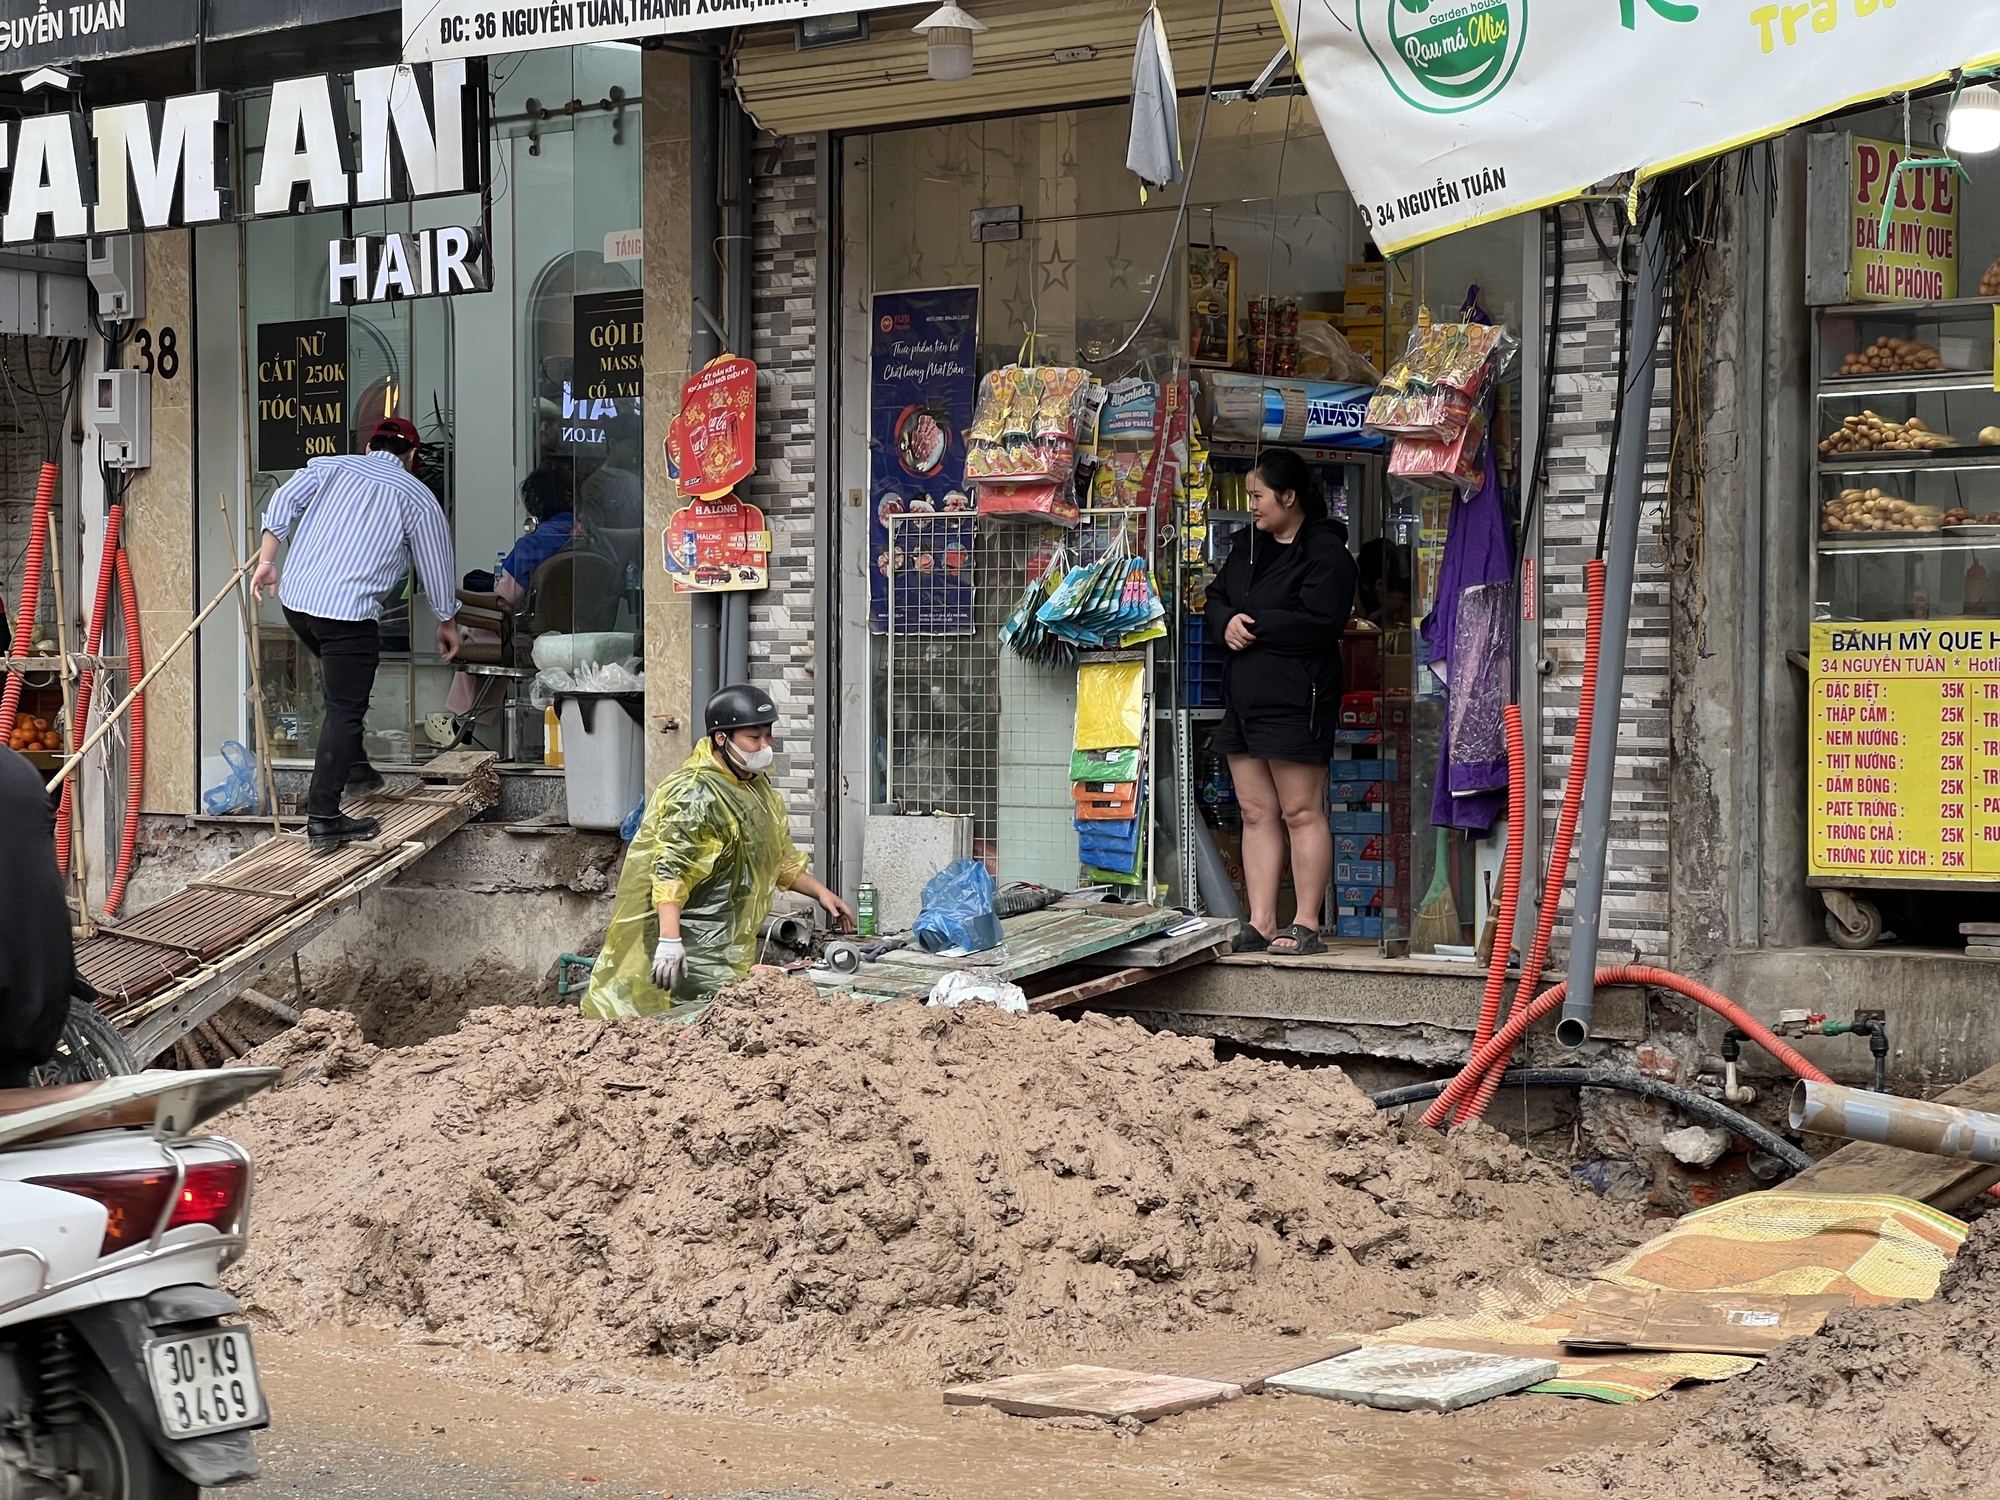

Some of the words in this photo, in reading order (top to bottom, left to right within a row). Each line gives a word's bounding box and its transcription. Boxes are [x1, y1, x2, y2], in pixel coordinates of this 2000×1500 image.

[1429, 5, 1468, 25] Garden
[440, 16, 470, 44] ĐC:
[475, 12, 496, 40] 36
[1404, 36, 1442, 68] Rau
[1442, 26, 1469, 54] má
[1468, 12, 1507, 47] Mix
[0, 67, 221, 243] ÂM
[254, 58, 466, 215] AN
[1376, 203, 1395, 227] 34
[1397, 178, 1461, 220] NGUYỄN
[1461, 167, 1507, 200] TUÂN
[1926, 226, 1953, 260] QUE
[329, 226, 475, 304] HAIR
[1866, 254, 1890, 296] HẢI
[1895, 261, 1943, 300] PHÒNG
[300, 330, 327, 358] NỮ
[590, 319, 627, 352] GỘI
[133, 326, 179, 380] 38
[258, 352, 296, 383] CẮT
[305, 363, 346, 384] 250K
[617, 381, 640, 397] VAI
[258, 393, 297, 421] TÓC
[300, 402, 342, 427] NAM
[305, 435, 337, 455] 80K
[696, 503, 738, 515] HALONG
[1832, 628, 1892, 651] BÁNH
[1938, 631, 1983, 653] QUE
[1821, 658, 1838, 673] 34
[1842, 654, 1901, 673] NGUYỄN
[1905, 654, 1946, 672] TUÂN
[1826, 681, 1850, 701] ĐẶC
[1854, 680, 1879, 701] BIỆT
[1941, 683, 1964, 698] 35K
[1983, 684, 2000, 698] TR
[1826, 704, 1856, 725] THẬP
[1860, 701, 1887, 722] CẨM
[1941, 707, 1964, 722] 25K
[1983, 712, 2000, 727] TR
[1826, 730, 1852, 745] NEM
[1857, 728, 1898, 746] NƯỚNG
[1941, 731, 1964, 746] 25K
[1983, 741, 2000, 755] TR
[1826, 754, 1851, 772] THỊT
[1855, 751, 1896, 770] NƯỚNG
[1940, 755, 1964, 771] 25K
[1826, 775, 1853, 793] DĂM
[1857, 775, 1890, 793] BÔNG
[1940, 779, 1964, 795] 25K
[1983, 769, 2000, 784] TR
[1826, 801, 1853, 816] PATE
[1858, 798, 1897, 817] TRỨNG
[1941, 803, 1964, 818] 25K
[1984, 797, 2000, 812] PA
[1826, 822, 1866, 840] TRỨNG
[1870, 821, 1894, 841] CHẢ
[1941, 827, 1964, 843] 25K
[1826, 845, 1866, 863] TRỨNG
[1870, 846, 1894, 865] XÚC
[1897, 847, 1926, 865] XÍCH
[1942, 851, 1965, 866] 25K
